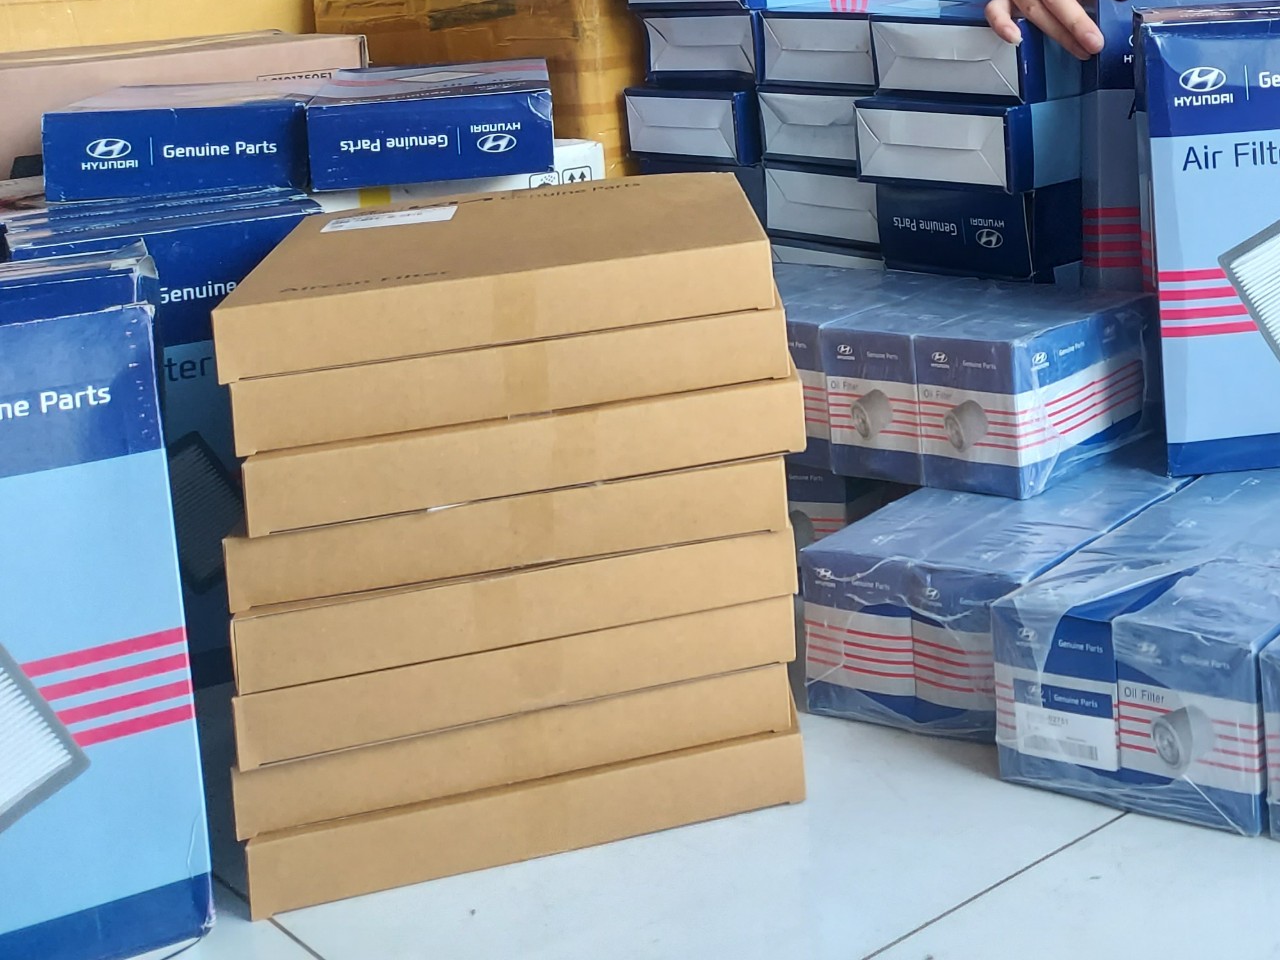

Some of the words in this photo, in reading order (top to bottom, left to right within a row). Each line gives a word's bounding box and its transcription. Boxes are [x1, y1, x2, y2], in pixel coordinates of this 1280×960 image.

[1174, 93, 1234, 107] HYUNDAI
[470, 121, 521, 133] HYUNDAI
[340, 138, 381, 152] Parts
[386, 134, 449, 149] Genuine
[81, 159, 139, 171] HYUNDAI
[163, 143, 230, 160] Genuine
[235, 139, 277, 157] Parts
[1182, 144, 1223, 171] Air
[893, 216, 917, 232] Parts
[919, 219, 957, 236] Genuine
[970, 217, 1005, 228] HYUNDAI
[40, 384, 112, 414] Parts
[1058, 638, 1084, 651] Genuine
[1086, 643, 1103, 654] Parts
[1053, 693, 1078, 706] Genuine
[1080, 697, 1098, 709] Parts
[1124, 686, 1137, 698] Oil
[1141, 690, 1165, 703] Filter
